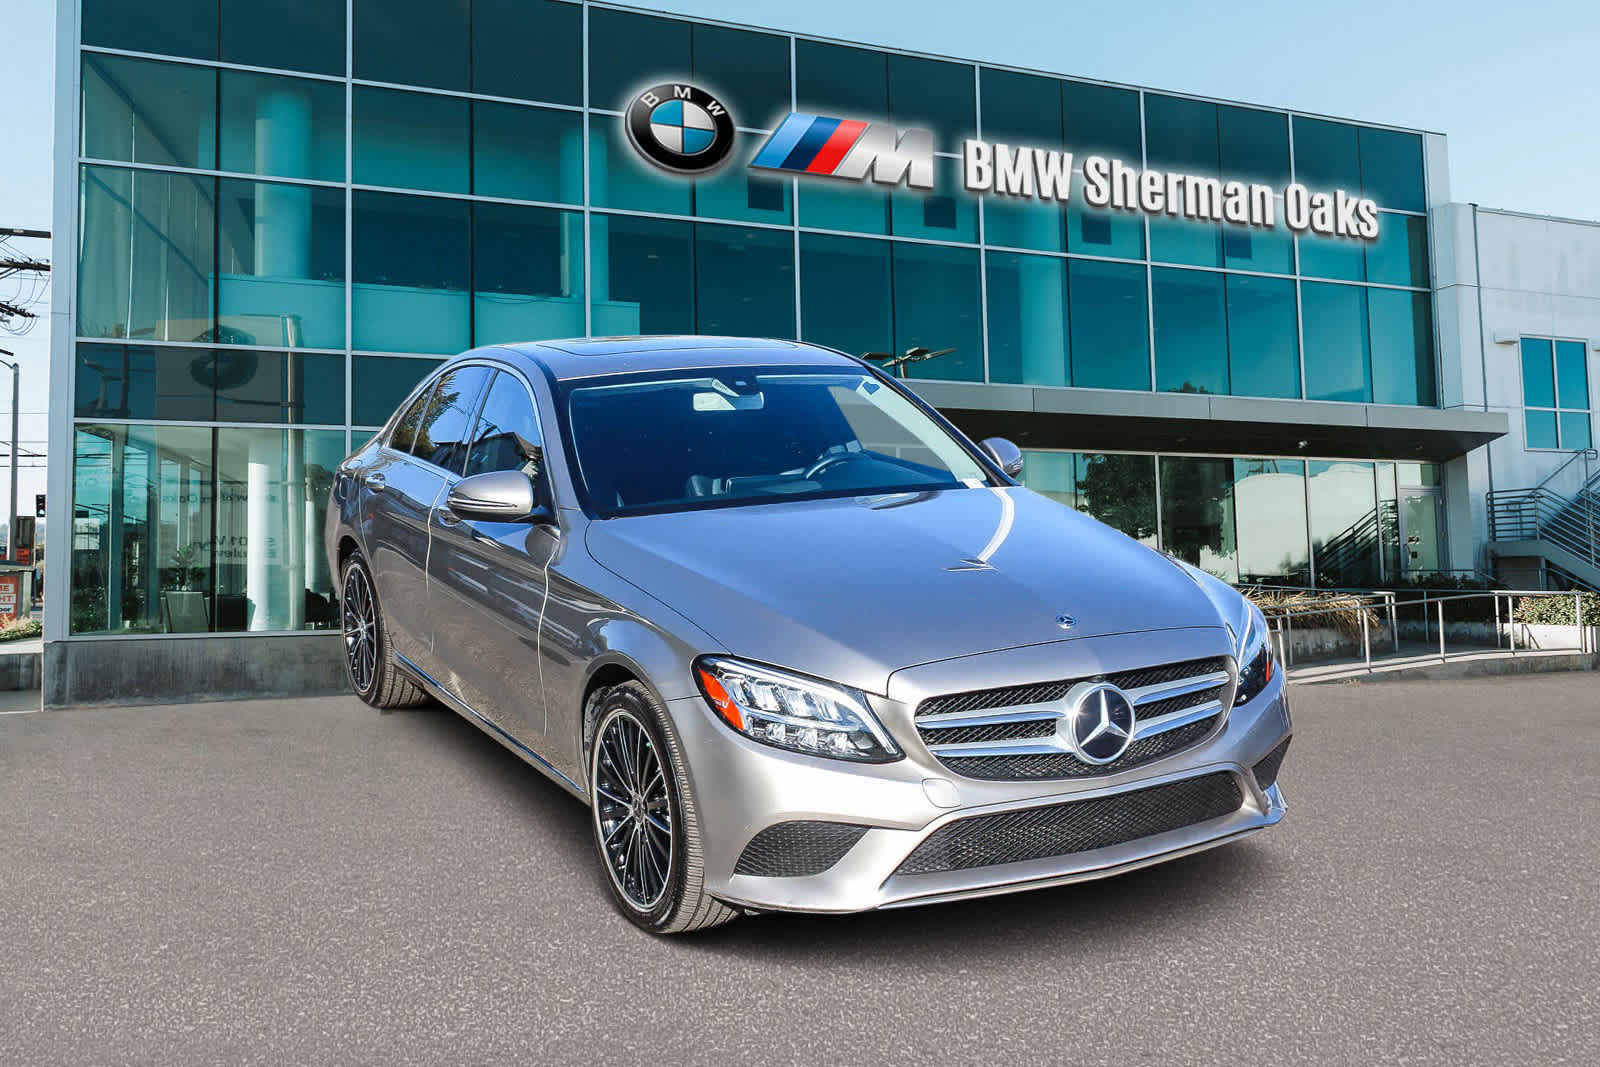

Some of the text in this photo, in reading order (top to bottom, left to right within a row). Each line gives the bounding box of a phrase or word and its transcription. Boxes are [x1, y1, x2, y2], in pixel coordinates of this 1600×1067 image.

[641, 85, 725, 117] BMW
[832, 122, 935, 188] M
[963, 139, 1379, 242] BMW Sherman Oaks
